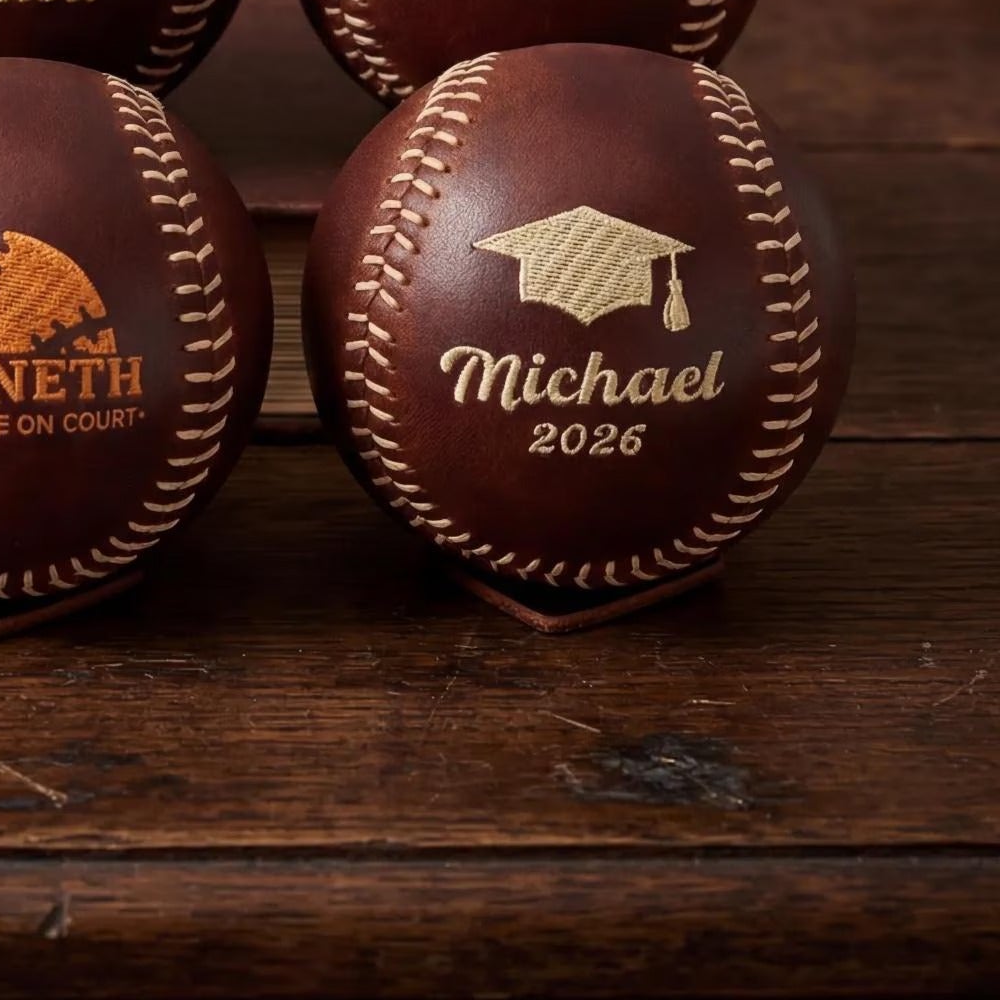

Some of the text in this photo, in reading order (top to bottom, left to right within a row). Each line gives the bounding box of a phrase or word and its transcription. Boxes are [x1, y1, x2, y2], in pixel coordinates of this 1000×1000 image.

[440, 346, 724, 411] Michael
[17, 414, 53, 434] ON
[528, 423, 647, 455] 2026
